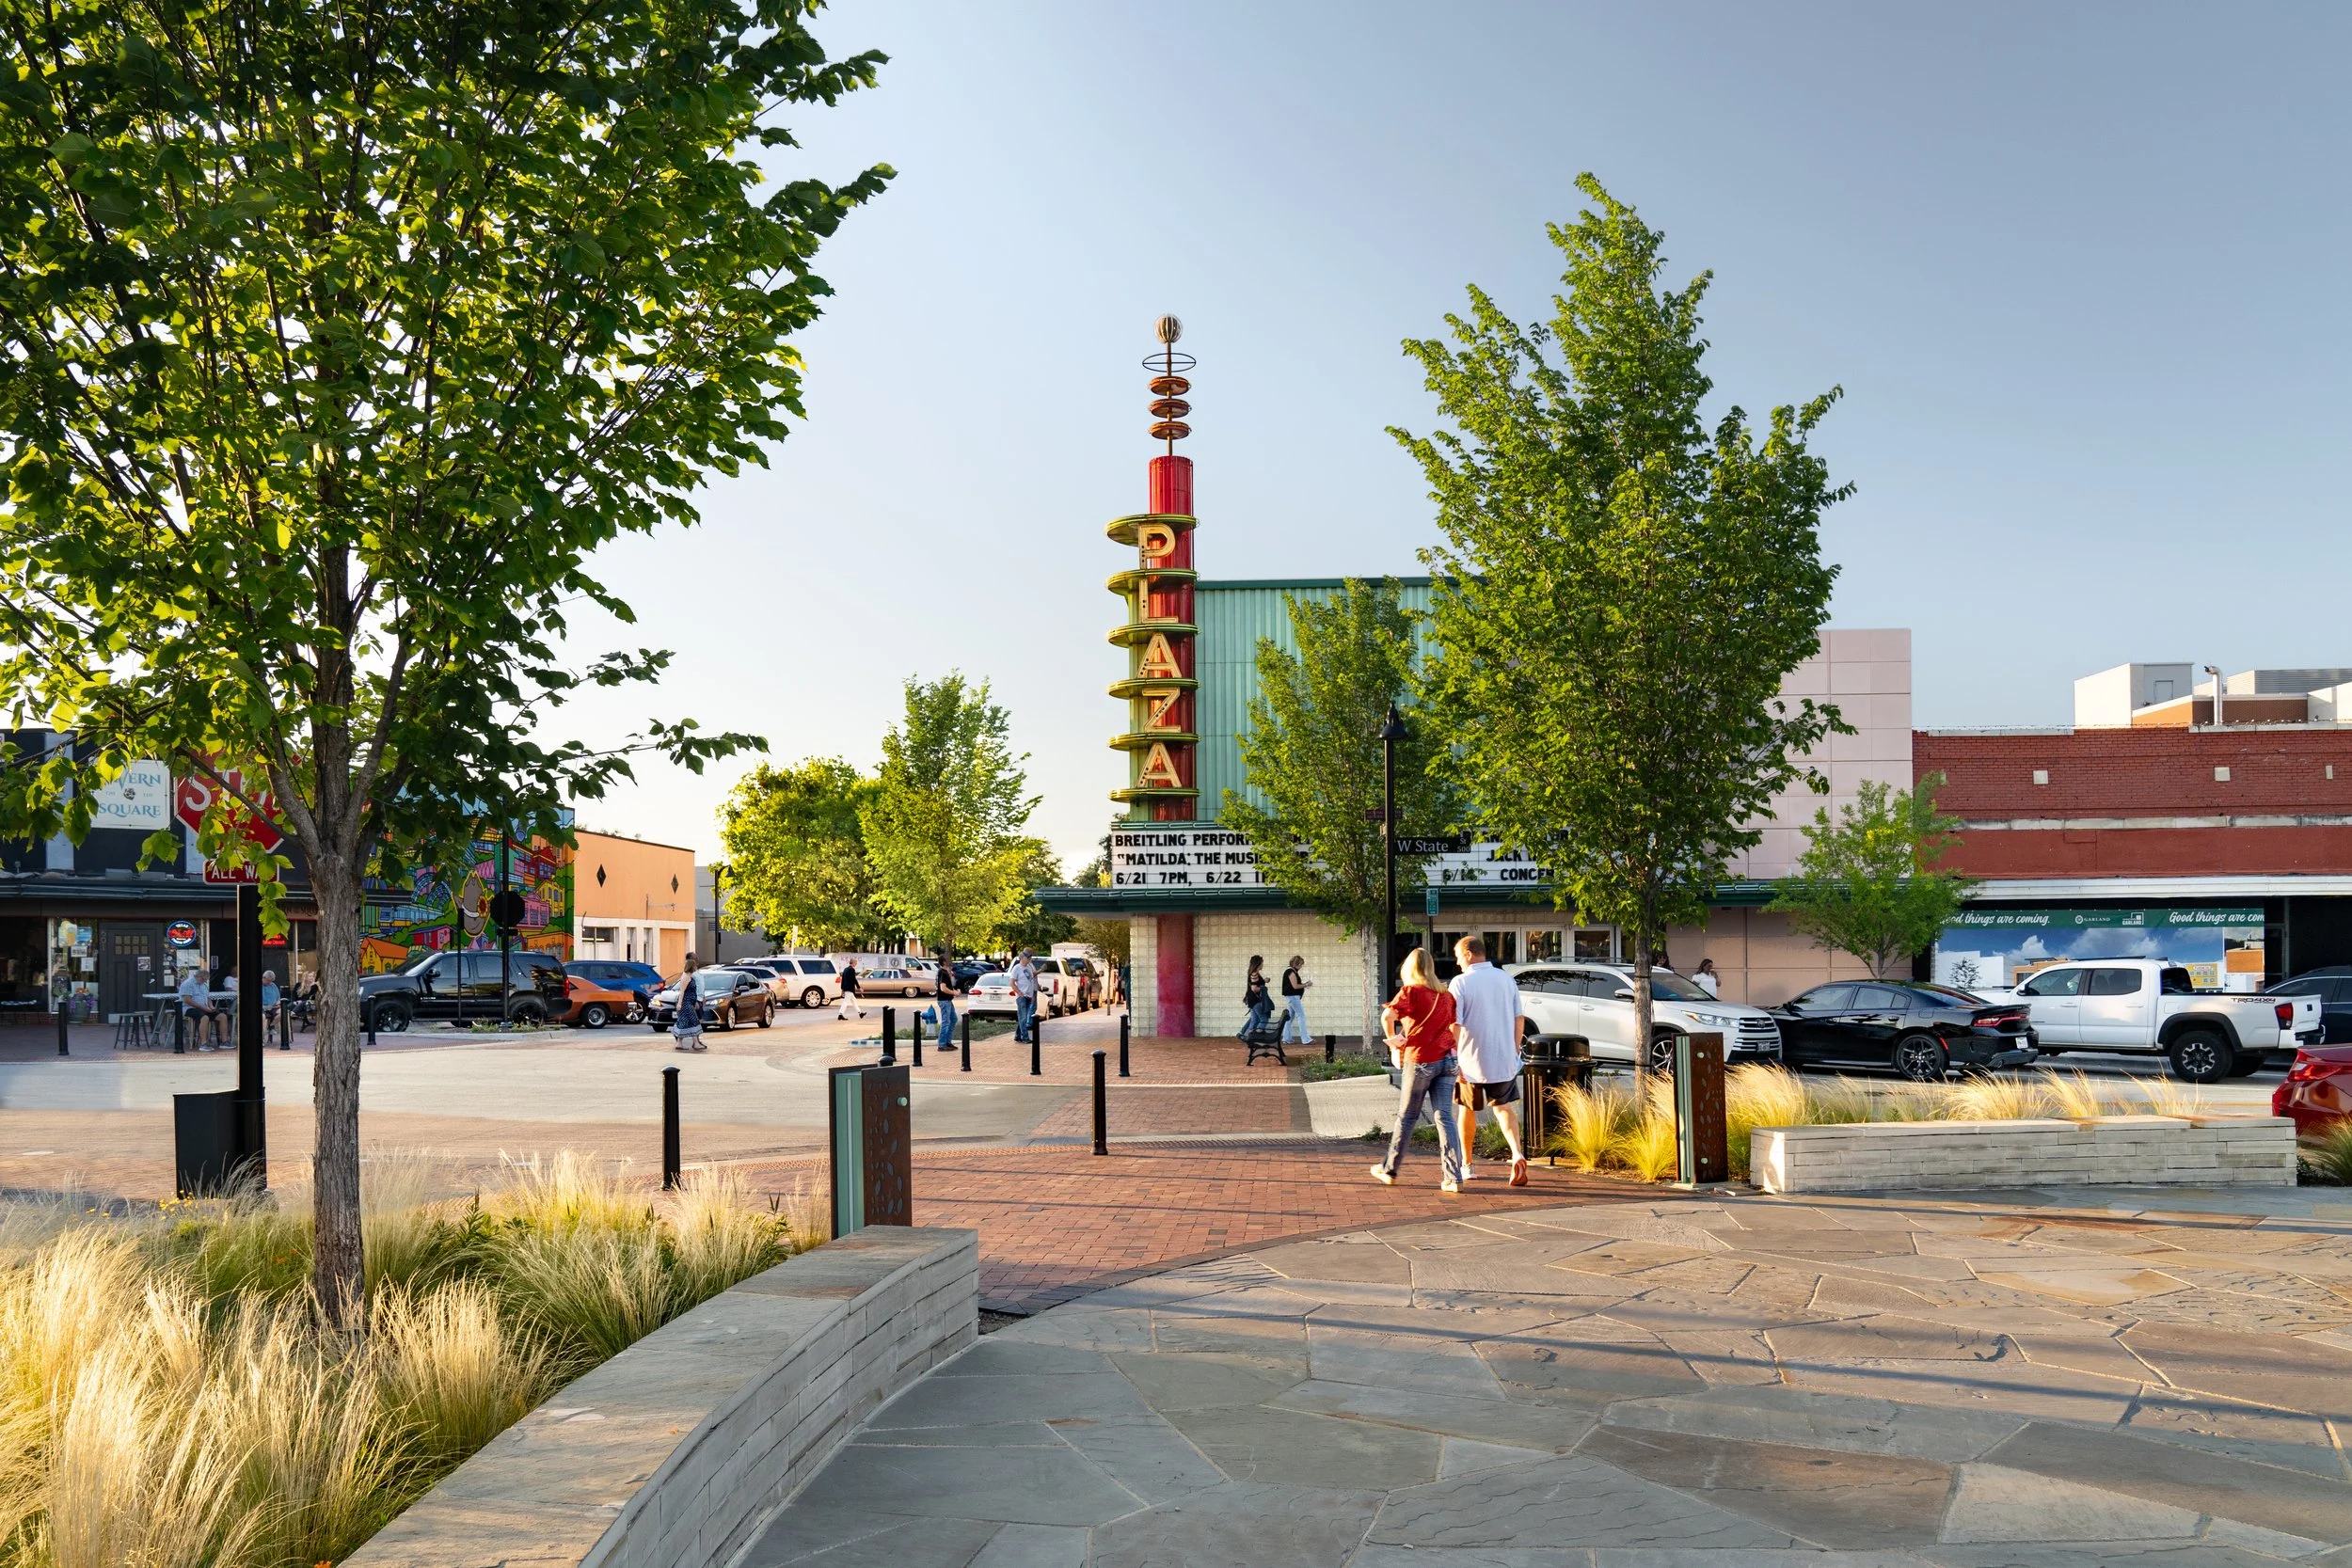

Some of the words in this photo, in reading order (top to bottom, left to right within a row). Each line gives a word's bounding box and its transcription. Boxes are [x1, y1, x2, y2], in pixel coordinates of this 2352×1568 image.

[1136, 522, 1182, 788] PLAZA
[118, 771, 161, 789] VERN
[99, 802, 161, 818] SQUARE
[1115, 833, 1186, 847] BREITLING
[1397, 840, 1411, 852] W
[1415, 840, 1449, 852] State
[1195, 852, 1221, 865] THE
[211, 863, 237, 879] ALL
[1116, 872, 1146, 885] 6/21
[1159, 871, 1192, 887] 7PM,
[1206, 871, 1242, 884] 6/22
[1964, 913, 1995, 927] things
[1996, 915, 2014, 924] are
[2015, 913, 2051, 927] coming.
[2169, 911, 2195, 924] Good
[2195, 911, 2227, 926] things
[2228, 913, 2246, 923] are
